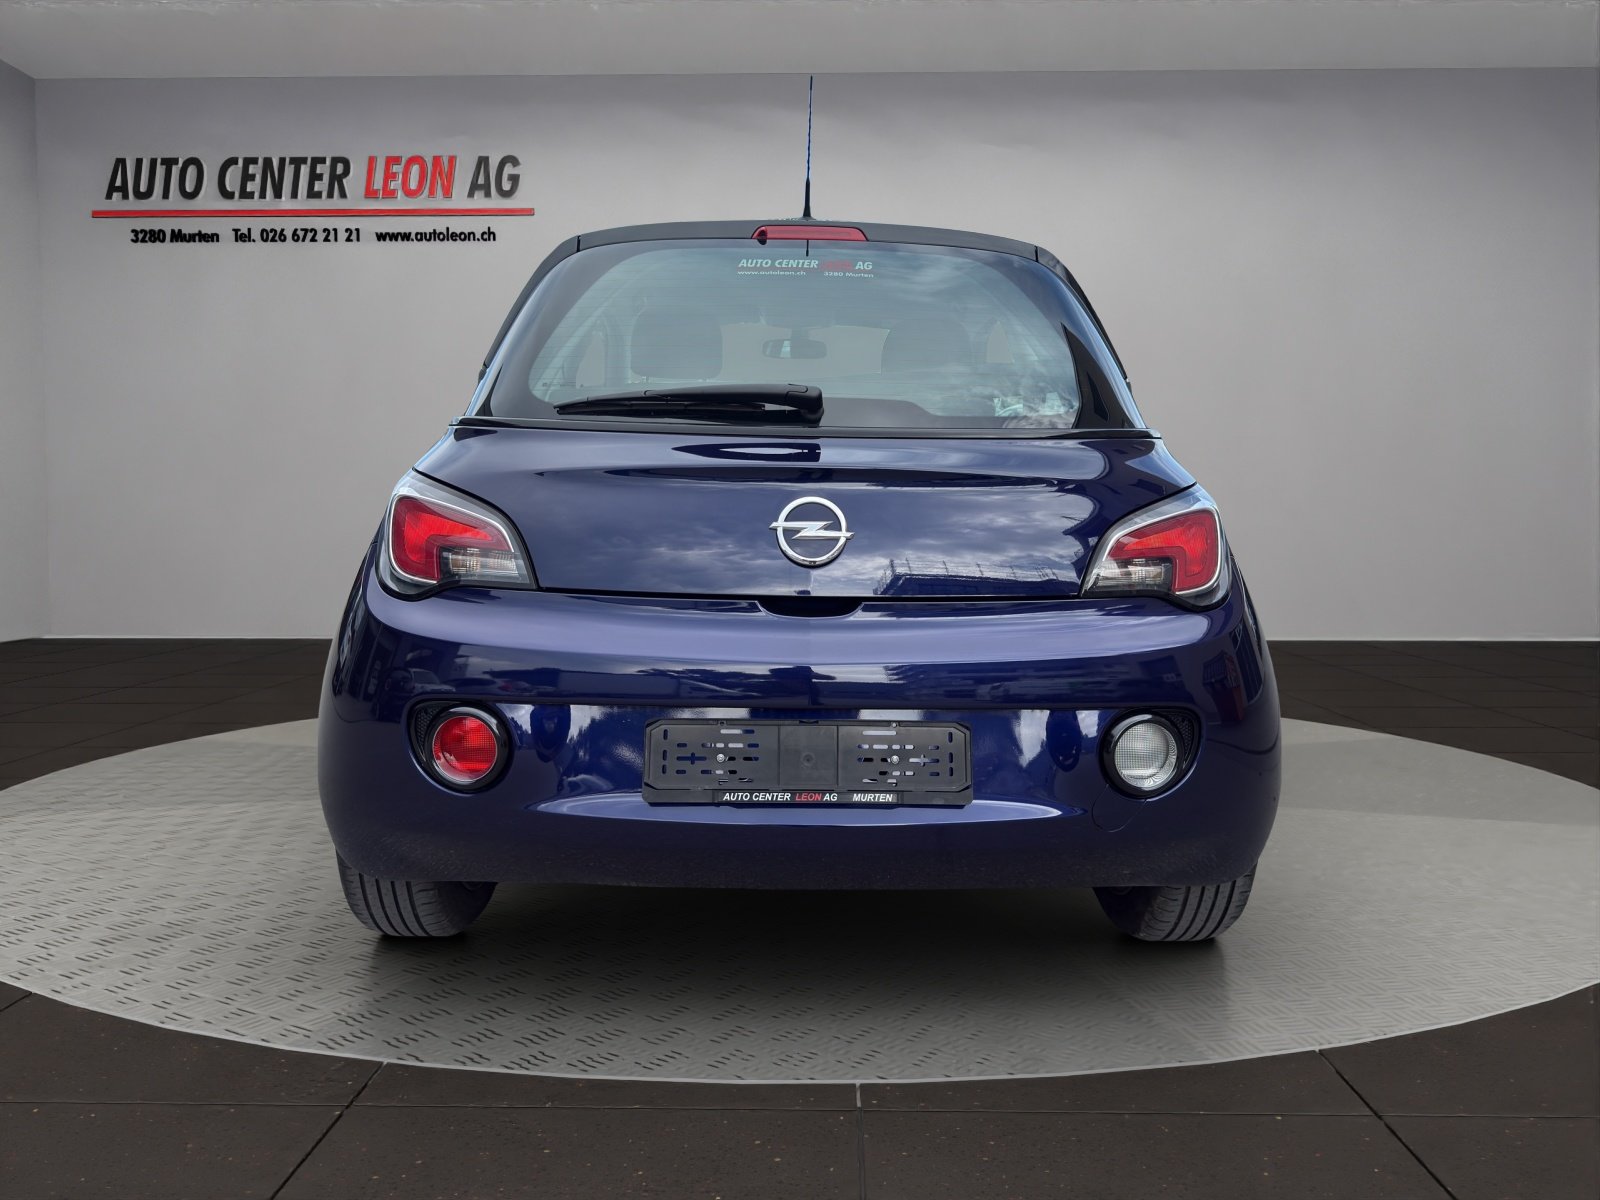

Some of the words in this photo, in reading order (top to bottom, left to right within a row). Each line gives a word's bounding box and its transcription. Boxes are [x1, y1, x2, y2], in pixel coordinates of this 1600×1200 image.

[106, 156, 206, 201] AUTO
[217, 155, 352, 200] CENTER
[363, 154, 458, 200] LEON
[467, 154, 522, 199] AG
[130, 228, 167, 243] 3280
[169, 228, 220, 243] Murten
[232, 227, 256, 243] Tel.
[260, 228, 287, 243] 026
[291, 228, 318, 243] 672
[322, 227, 338, 242] 21
[344, 227, 361, 242] 21
[375, 226, 497, 242] www.autoleon.ch
[738, 258, 771, 268] AUTO
[774, 259, 819, 269] CENTER
[855, 261, 873, 270] AG
[722, 792, 751, 802] AUTO
[752, 792, 791, 802] CENTER
[795, 792, 822, 802] LEON
[823, 793, 838, 802] AG
[852, 793, 893, 803] MURTEN
